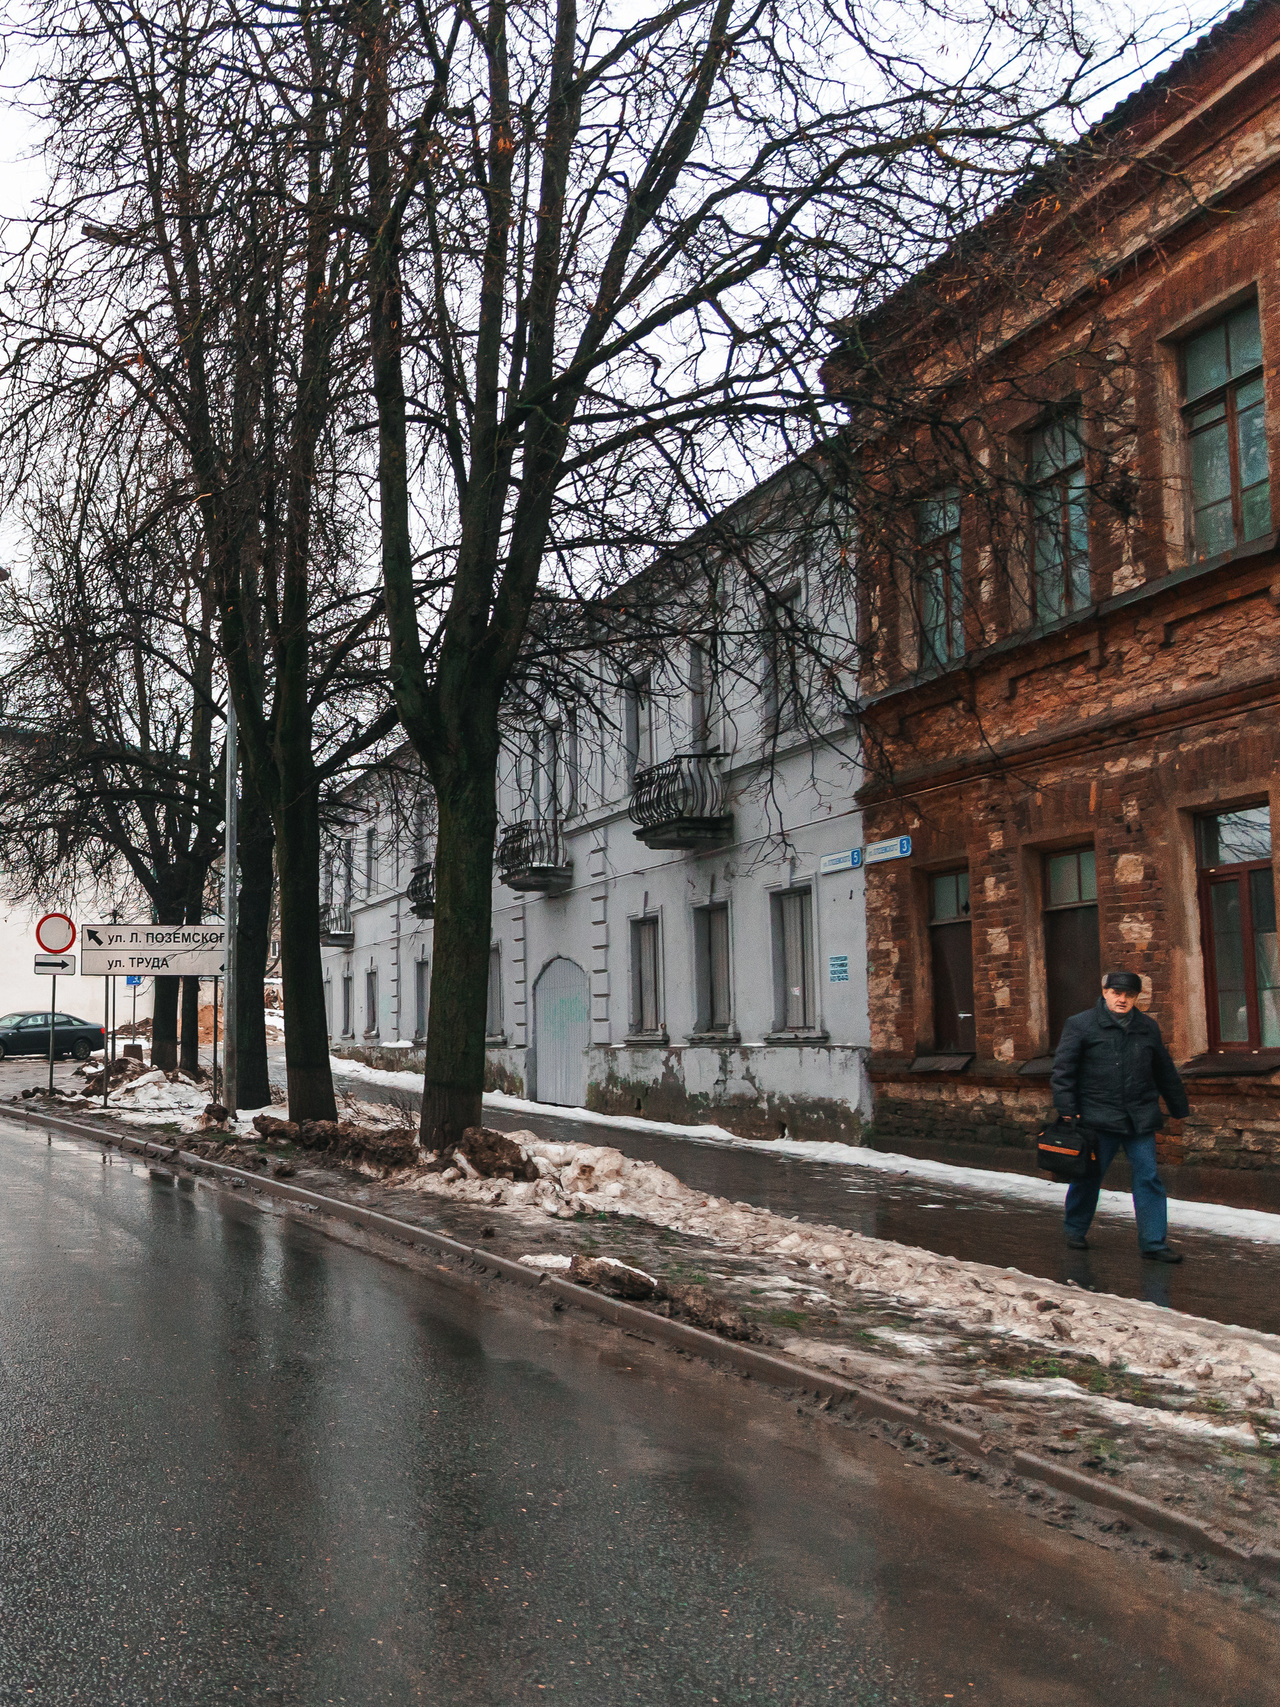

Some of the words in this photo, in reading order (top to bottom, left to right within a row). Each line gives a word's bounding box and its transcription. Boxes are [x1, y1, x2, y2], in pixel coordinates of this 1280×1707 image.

[901, 840, 908, 852] 3
[853, 851, 859, 863] 5
[107, 934, 126, 945] ул.
[129, 932, 142, 943] Л.
[107, 959, 125, 970] ул.
[129, 957, 169, 969] ТРУДА
